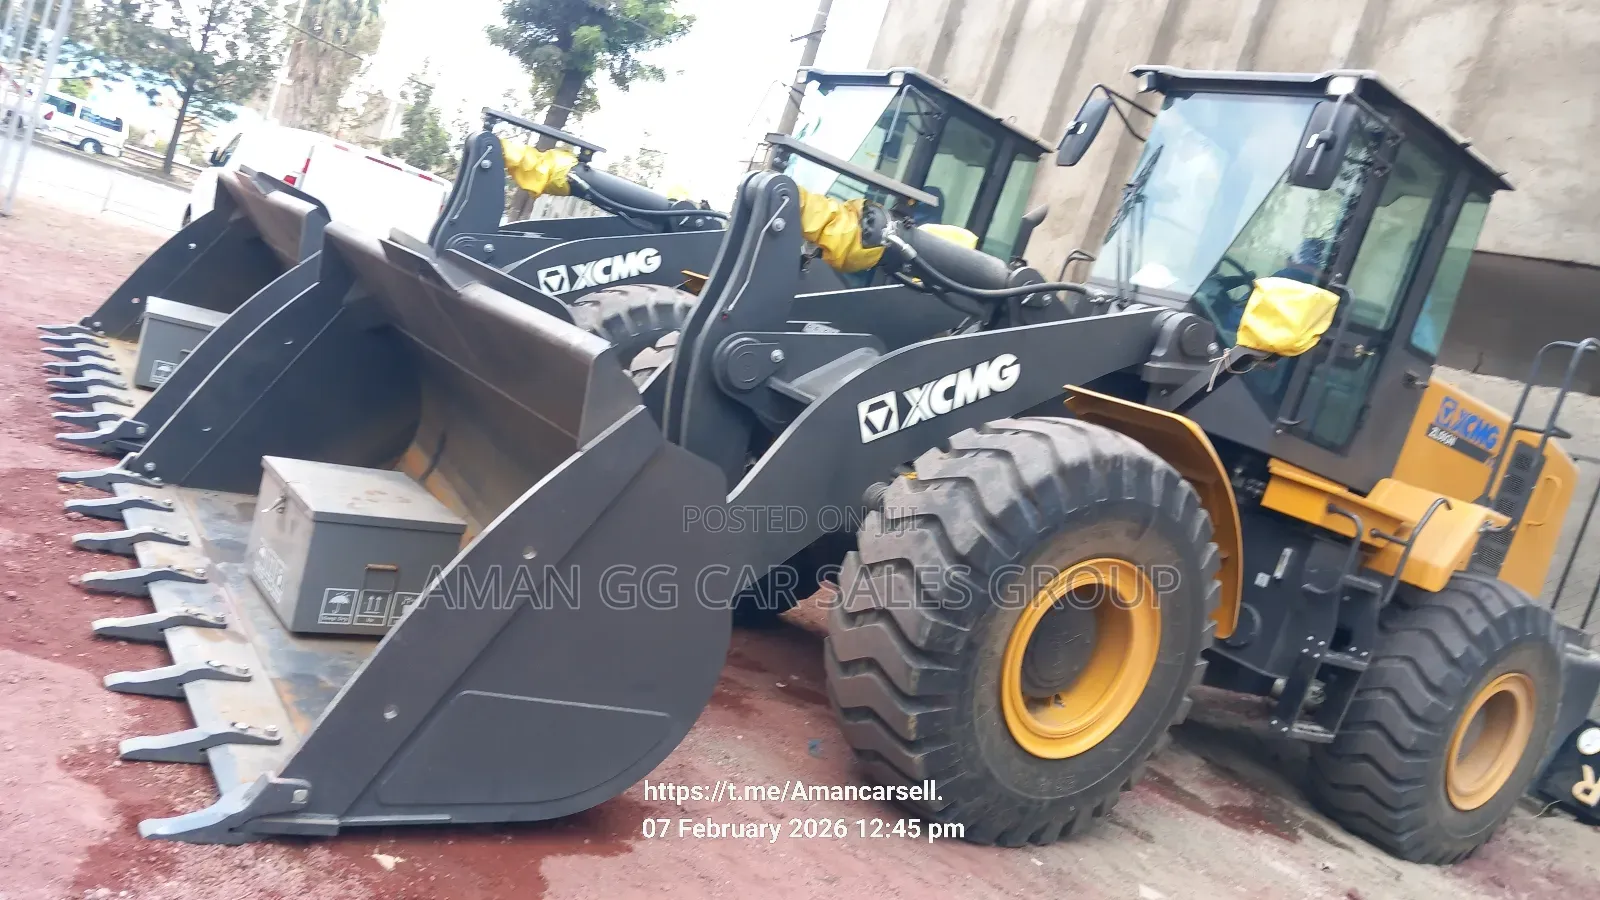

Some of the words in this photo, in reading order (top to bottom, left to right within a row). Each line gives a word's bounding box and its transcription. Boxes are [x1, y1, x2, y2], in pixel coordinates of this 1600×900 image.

[571, 247, 662, 291] XCMG
[900, 353, 1021, 430] XCMG
[1452, 408, 1500, 451] XCMG
